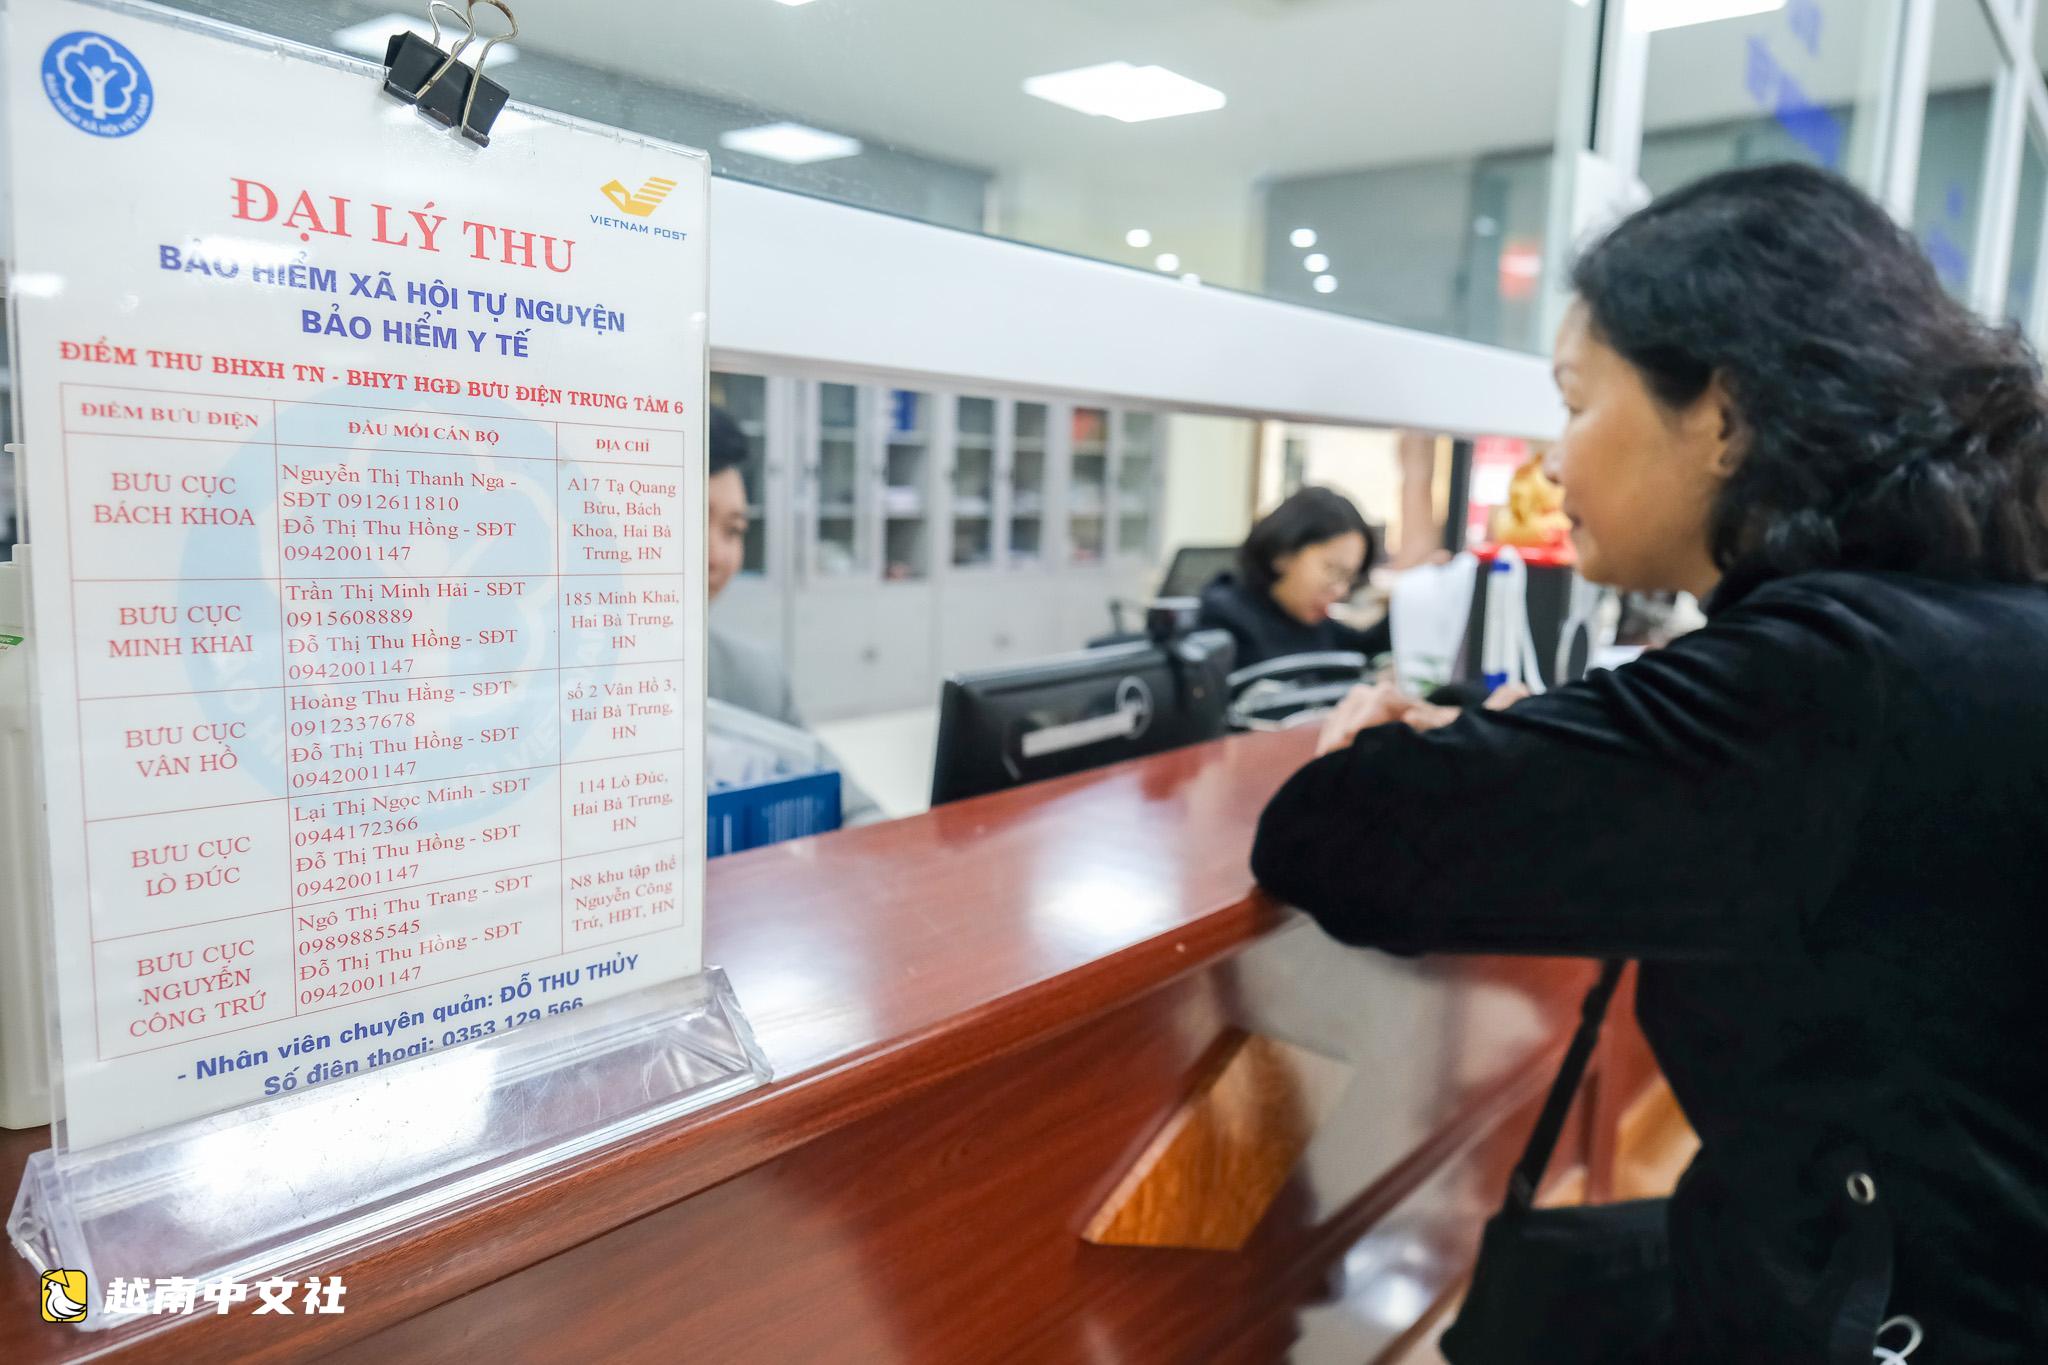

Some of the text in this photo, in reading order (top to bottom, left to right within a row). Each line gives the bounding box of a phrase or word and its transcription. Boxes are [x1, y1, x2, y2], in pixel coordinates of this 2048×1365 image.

[230, 177, 576, 273] ĐẠI LÝ THU
[590, 214, 687, 240] VIETNAM POST
[349, 271, 397, 301] XÃ
[408, 279, 457, 314] HỘI
[468, 290, 507, 322] TỰ
[515, 297, 624, 336] NGUYỆN
[301, 303, 532, 358] BẢO HIỂM Y TẾ
[60, 336, 683, 414] ĐIỂM THU BHXH TN BHYT HGĐ BƯU ĐIỆN TRUNG TÂM 6
[151, 408, 199, 423] BƯU
[208, 412, 258, 429] ĐIỆN
[475, 430, 499, 446] BỘ
[596, 439, 620, 453] ĐỊA
[112, 472, 236, 498] BƯU CỤC
[282, 464, 504, 491] Nguyễn Thị Thanh Nga
[568, 478, 676, 498] A17 Tạ Quang
[94, 501, 256, 526] BÁCH KHOA
[283, 492, 458, 511] SĐT 0912611810
[626, 502, 661, 515] Bách
[283, 516, 516, 539] Đỗ Thị Thu Hồng SĐT
[572, 524, 647, 539] Khoa, Hai
[284, 546, 411, 560] 0942001147
[639, 547, 661, 560] HN
[285, 581, 526, 602] Trần Thị Minh Hải SĐT
[566, 592, 636, 606] 185 Minh
[119, 605, 241, 627] BƯU CỤC
[287, 609, 413, 627] 0915608889
[571, 614, 622, 628] Hai Bà
[108, 635, 253, 658] MINH KHAI
[288, 629, 518, 653] Đỗ Thị Thu Hồng SĐT
[612, 635, 635, 649] HN
[289, 659, 413, 679] 0942001147
[291, 680, 512, 710] Hoàng Thu Hằng SĐT
[568, 677, 658, 700] số 2 Vân Hồ
[291, 712, 415, 736] 0912337678
[572, 705, 621, 722] Hai Bà
[125, 722, 246, 748] BƯU CỤC
[613, 725, 636, 739] HN
[291, 727, 519, 762] Đỗ Thị Thu Hồng SĐT
[136, 745, 238, 778] VÂN HỒ
[293, 761, 416, 788] 0942001147
[580, 776, 630, 793] 114 Lò
[294, 777, 530, 822] Lại Thị Ngọc Minh SĐT
[573, 801, 597, 816] Hai
[295, 816, 418, 847] 0944172366
[613, 816, 636, 832] HN
[131, 836, 250, 868] BƯU CỤC
[296, 824, 520, 872] Đỗ Thị Thu Hồng SĐT
[146, 865, 240, 896] LÒ ĐÚC
[297, 863, 419, 897] 0942001147
[571, 871, 623, 890] N8 khu
[297, 875, 532, 931] Ngô Thị Thu Trang SĐT
[652, 901, 673, 914] HN
[299, 919, 420, 956] 0989885545
[137, 940, 254, 976] BƯU CỤC
[300, 921, 522, 980] Đỗ Thị Thu Hồng SĐT
[300, 965, 422, 1005] 0942001147
[130, 990, 266, 1037] CÔNG TRỨ
[196, 952, 638, 1080] Nhân viên chuyên quản: ĐỖ THU THỦY
[264, 1066, 300, 1095] Số
[442, 1020, 496, 1046] 0353
